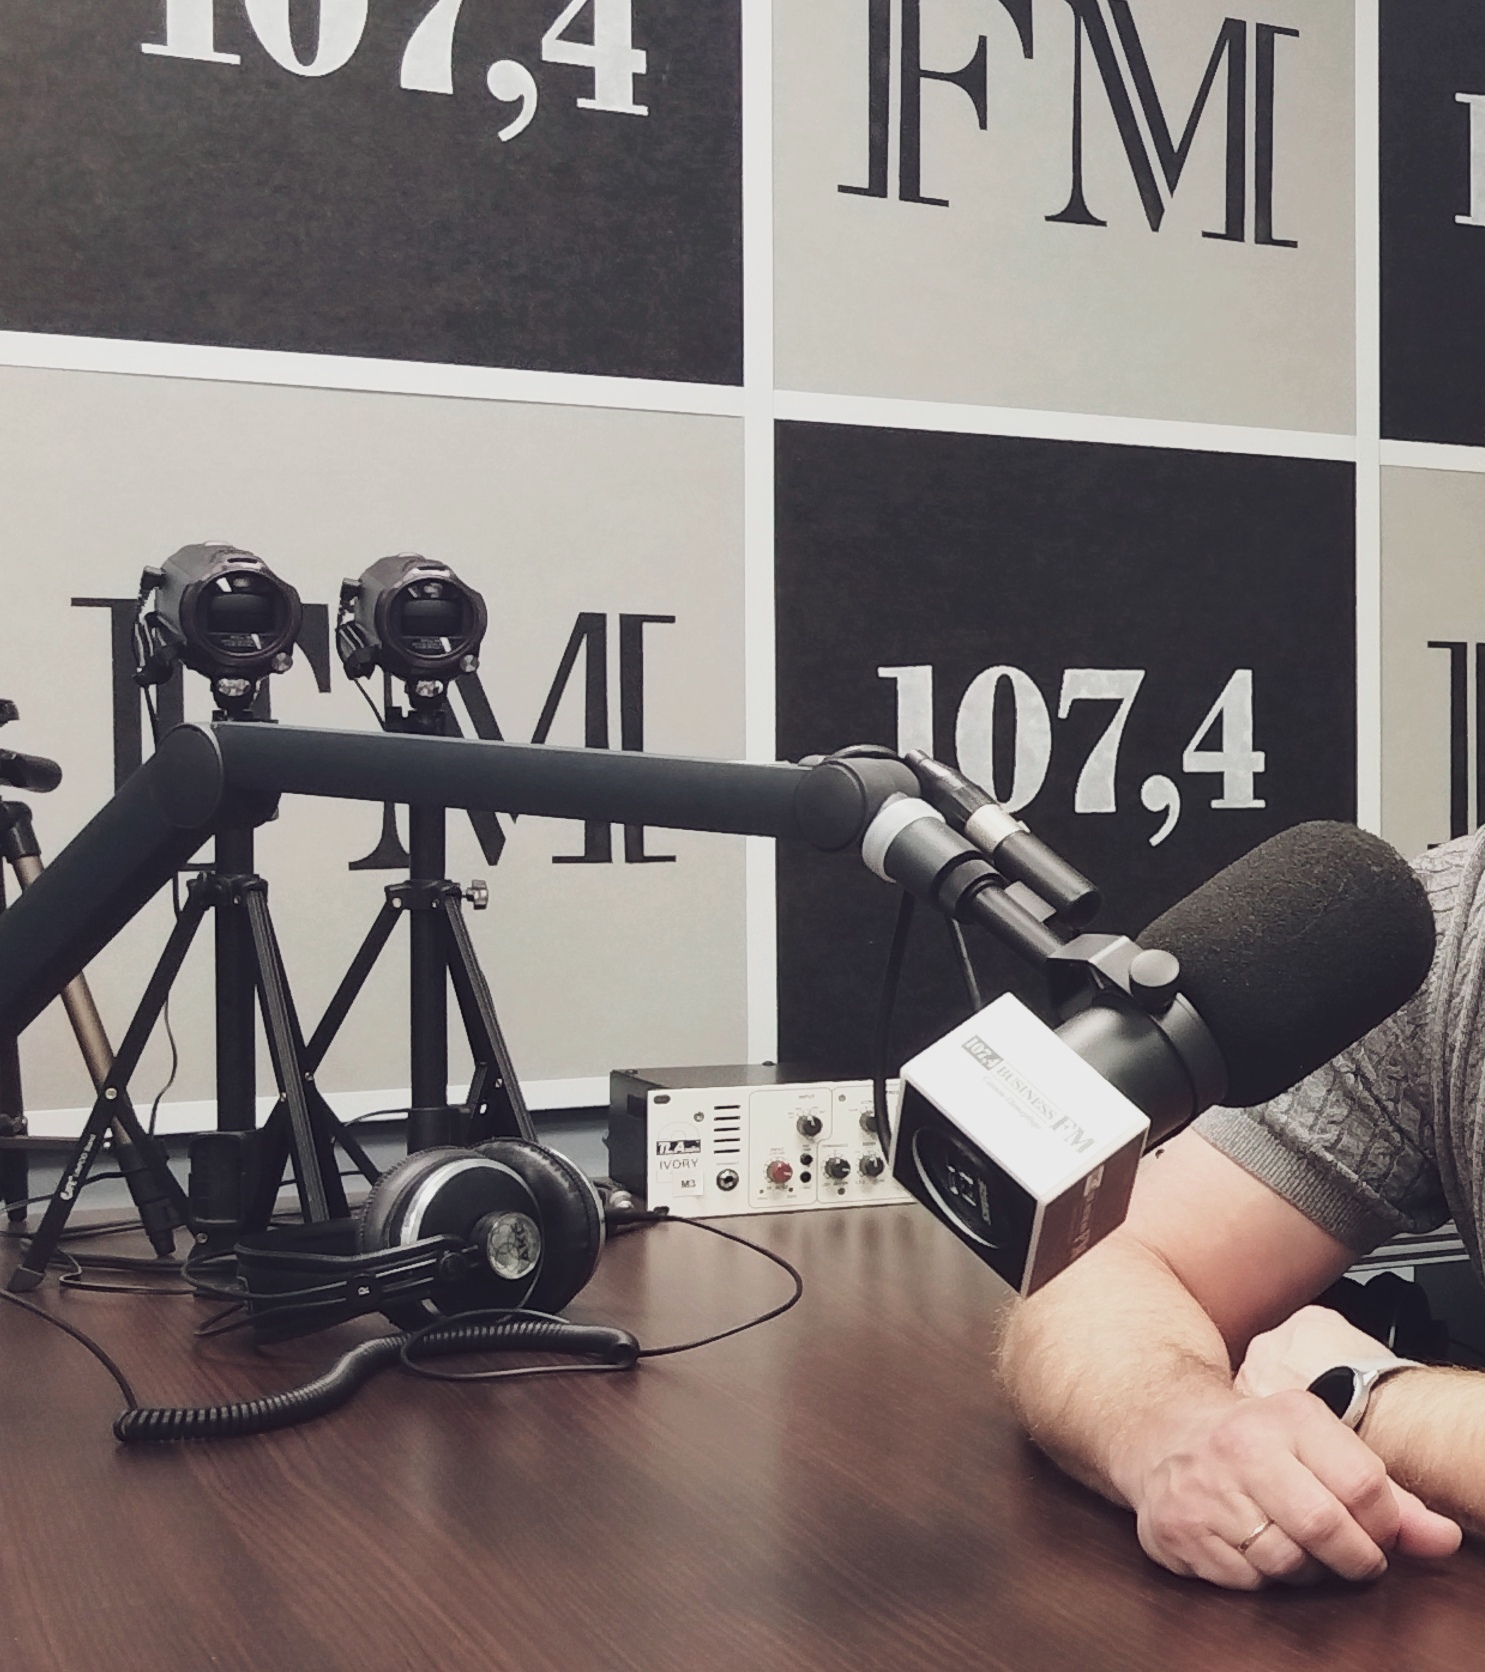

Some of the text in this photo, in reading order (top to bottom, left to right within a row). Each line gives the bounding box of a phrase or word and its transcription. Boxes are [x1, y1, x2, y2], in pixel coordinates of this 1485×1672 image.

[837, 0, 1300, 249] FM
[877, 664, 1267, 847] 107,4
[996, 1065, 1058, 1120] BUSINESS
[1049, 1115, 1096, 1155] FM
[659, 1157, 698, 1170] IVORY
[680, 1179, 697, 1189] M3
